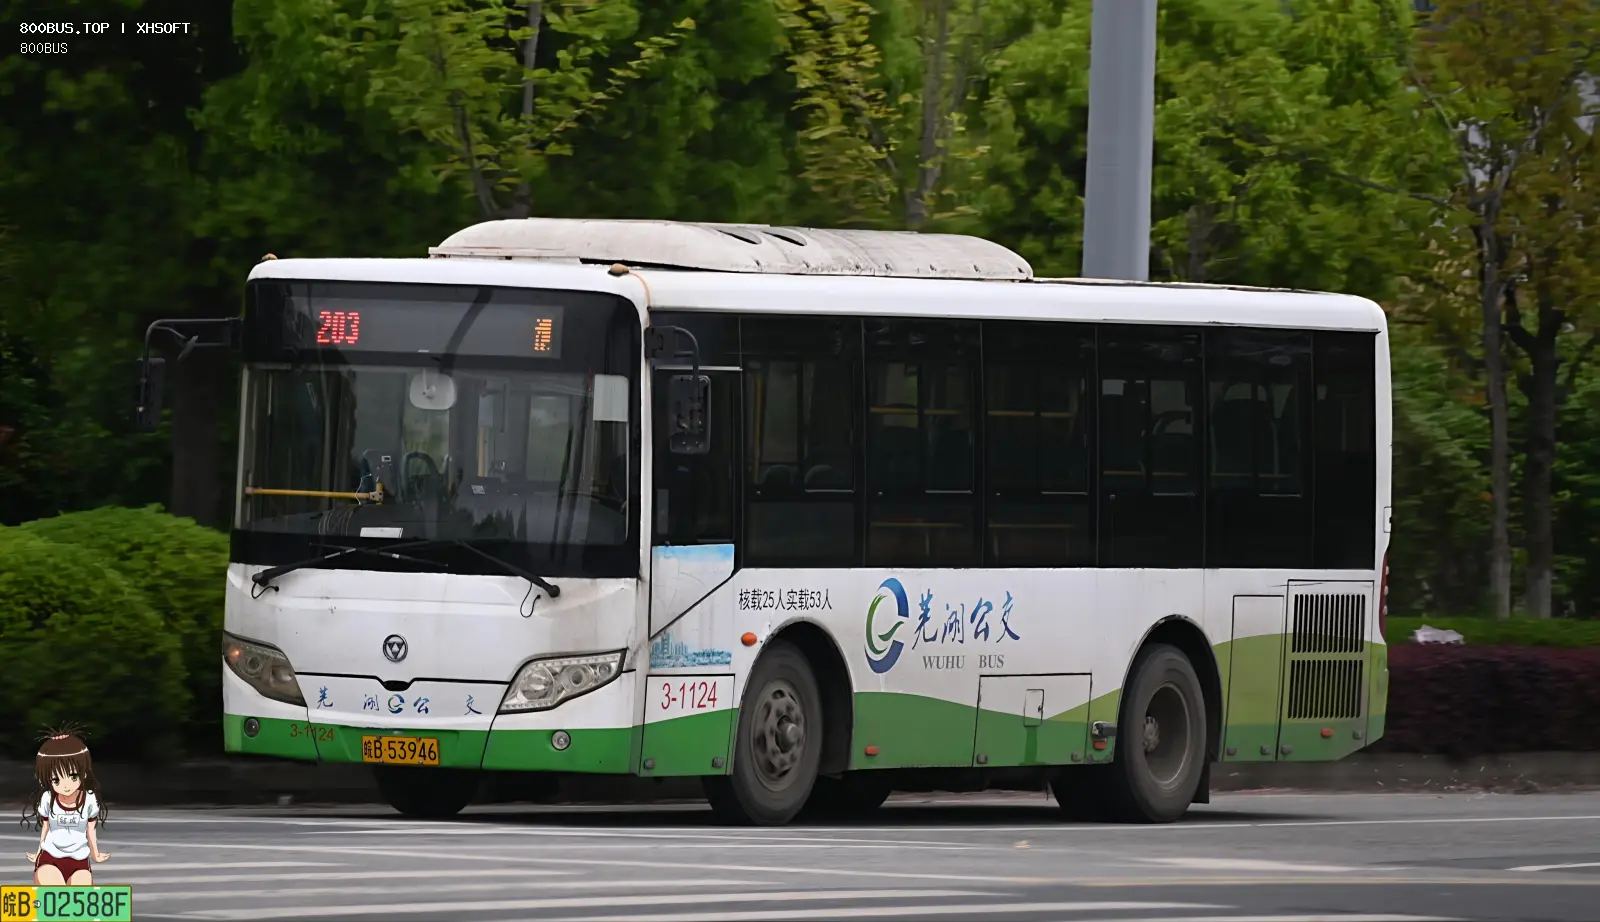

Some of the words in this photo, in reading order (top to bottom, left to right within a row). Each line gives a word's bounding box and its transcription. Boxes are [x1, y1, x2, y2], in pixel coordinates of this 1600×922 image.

[316, 311, 360, 344] 203
[738, 588, 833, 611] 核载25人实载53人
[912, 588, 1021, 650] 芜湖公交
[922, 655, 966, 670] WUHU
[978, 654, 1005, 669] BUS
[661, 681, 718, 710] 3-1124
[290, 723, 335, 742] 3-1124
